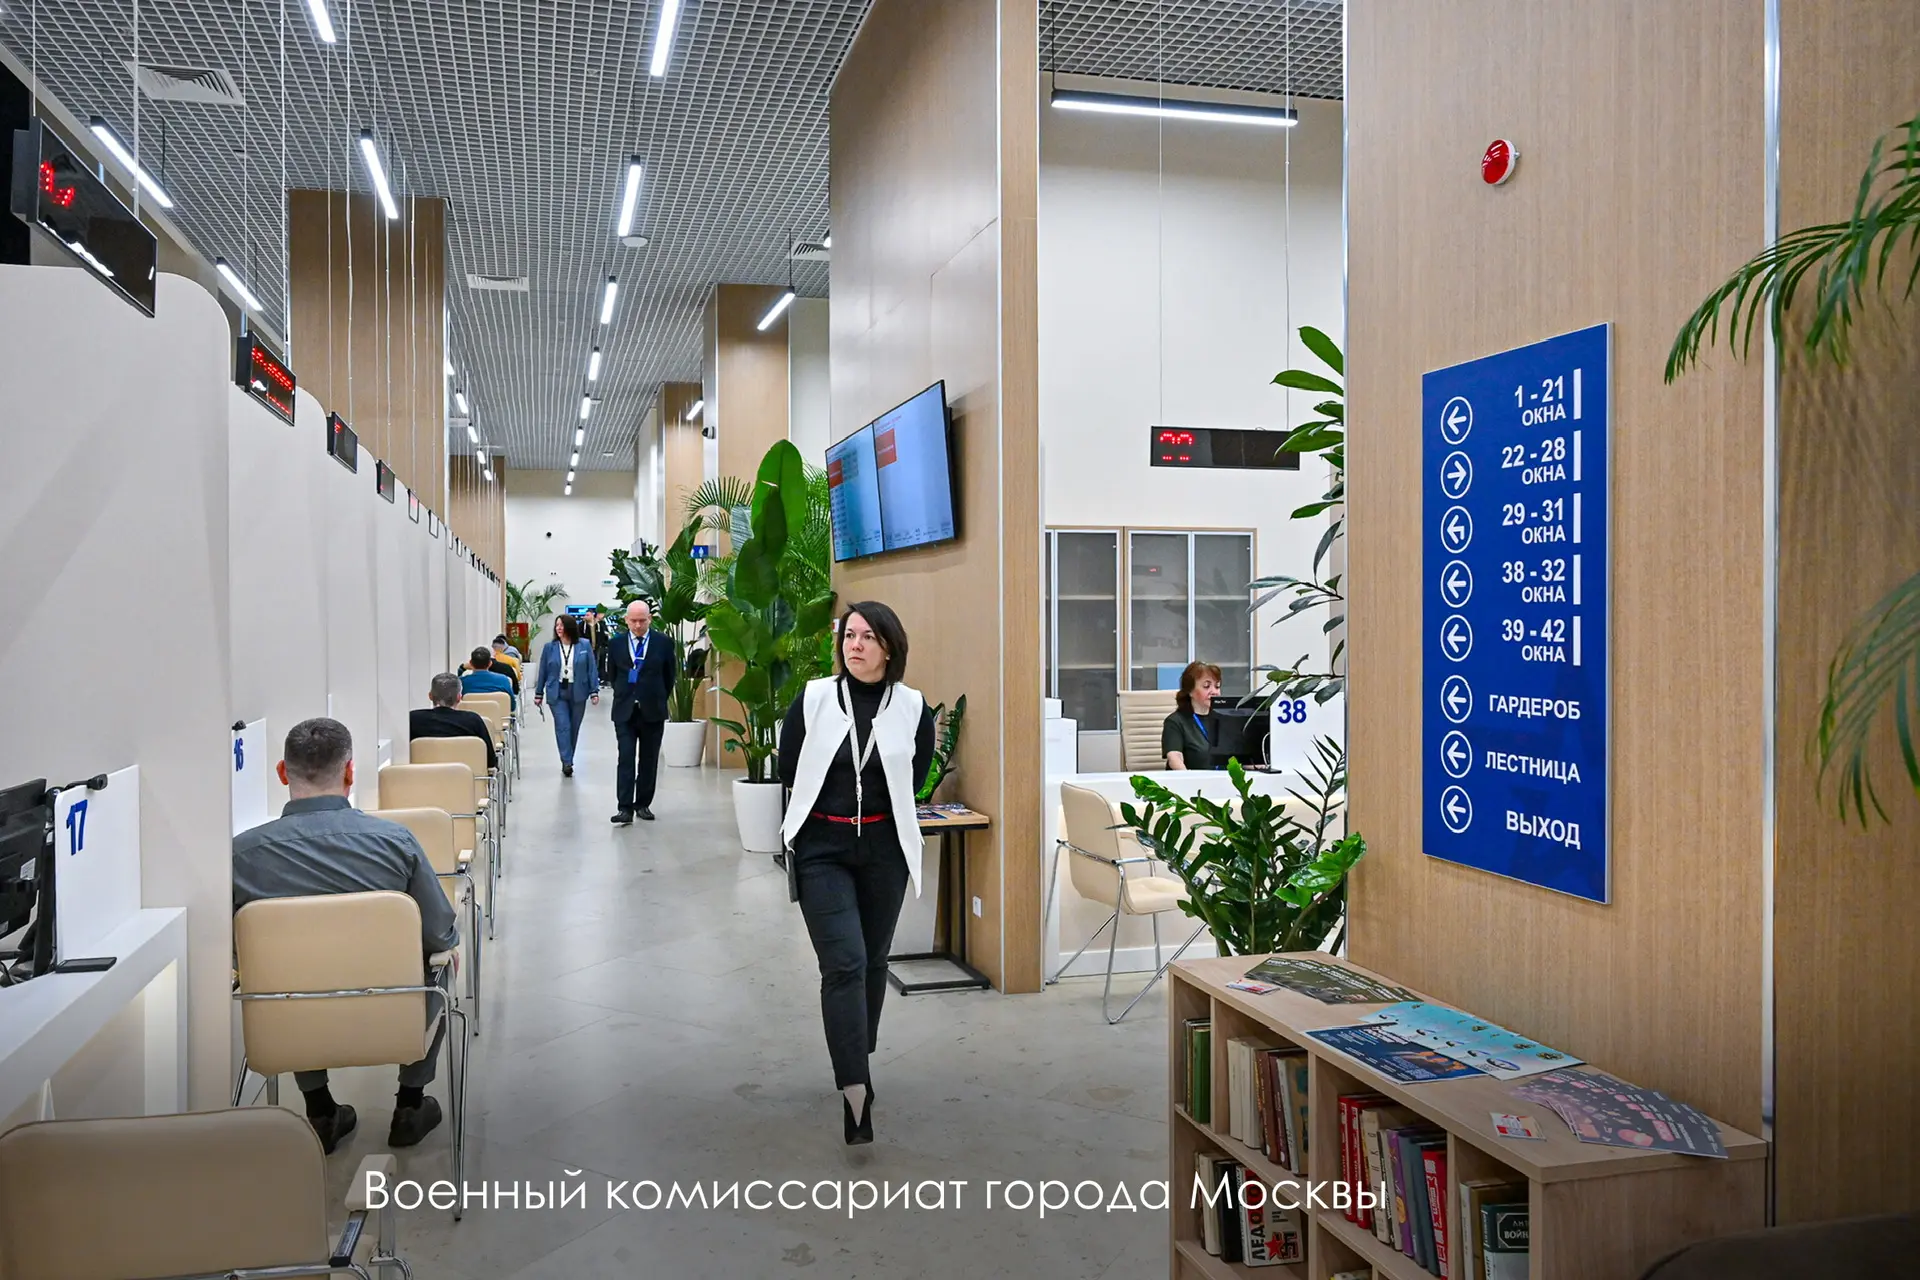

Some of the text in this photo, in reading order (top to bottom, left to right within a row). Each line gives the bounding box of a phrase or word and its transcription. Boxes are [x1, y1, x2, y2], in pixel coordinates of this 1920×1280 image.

[1514, 385, 1523, 408] 1
[1541, 375, 1563, 403] 21
[1521, 403, 1567, 427] ОКНА
[1501, 444, 1525, 470] 22
[1541, 436, 1566, 463] 28
[1521, 463, 1566, 486] ОКНА
[1502, 502, 1525, 526] 29
[1542, 497, 1563, 522] 31
[1521, 524, 1566, 545] ОКНА
[1502, 560, 1525, 584] 38
[1541, 558, 1565, 582] 32
[1521, 585, 1566, 604] ОКНА
[1502, 619, 1525, 642] 39
[1540, 618, 1565, 643] 42
[1521, 644, 1566, 663] ОКНА
[1277, 699, 1307, 724] 38
[1489, 694, 1581, 720] ГАРДЕРОБ
[1485, 751, 1581, 785] ЛЕСТНИЦА
[66, 799, 88, 856] 17
[1506, 810, 1581, 850] ВЫХОД
[1503, 1229, 1529, 1240] ВОЙН
